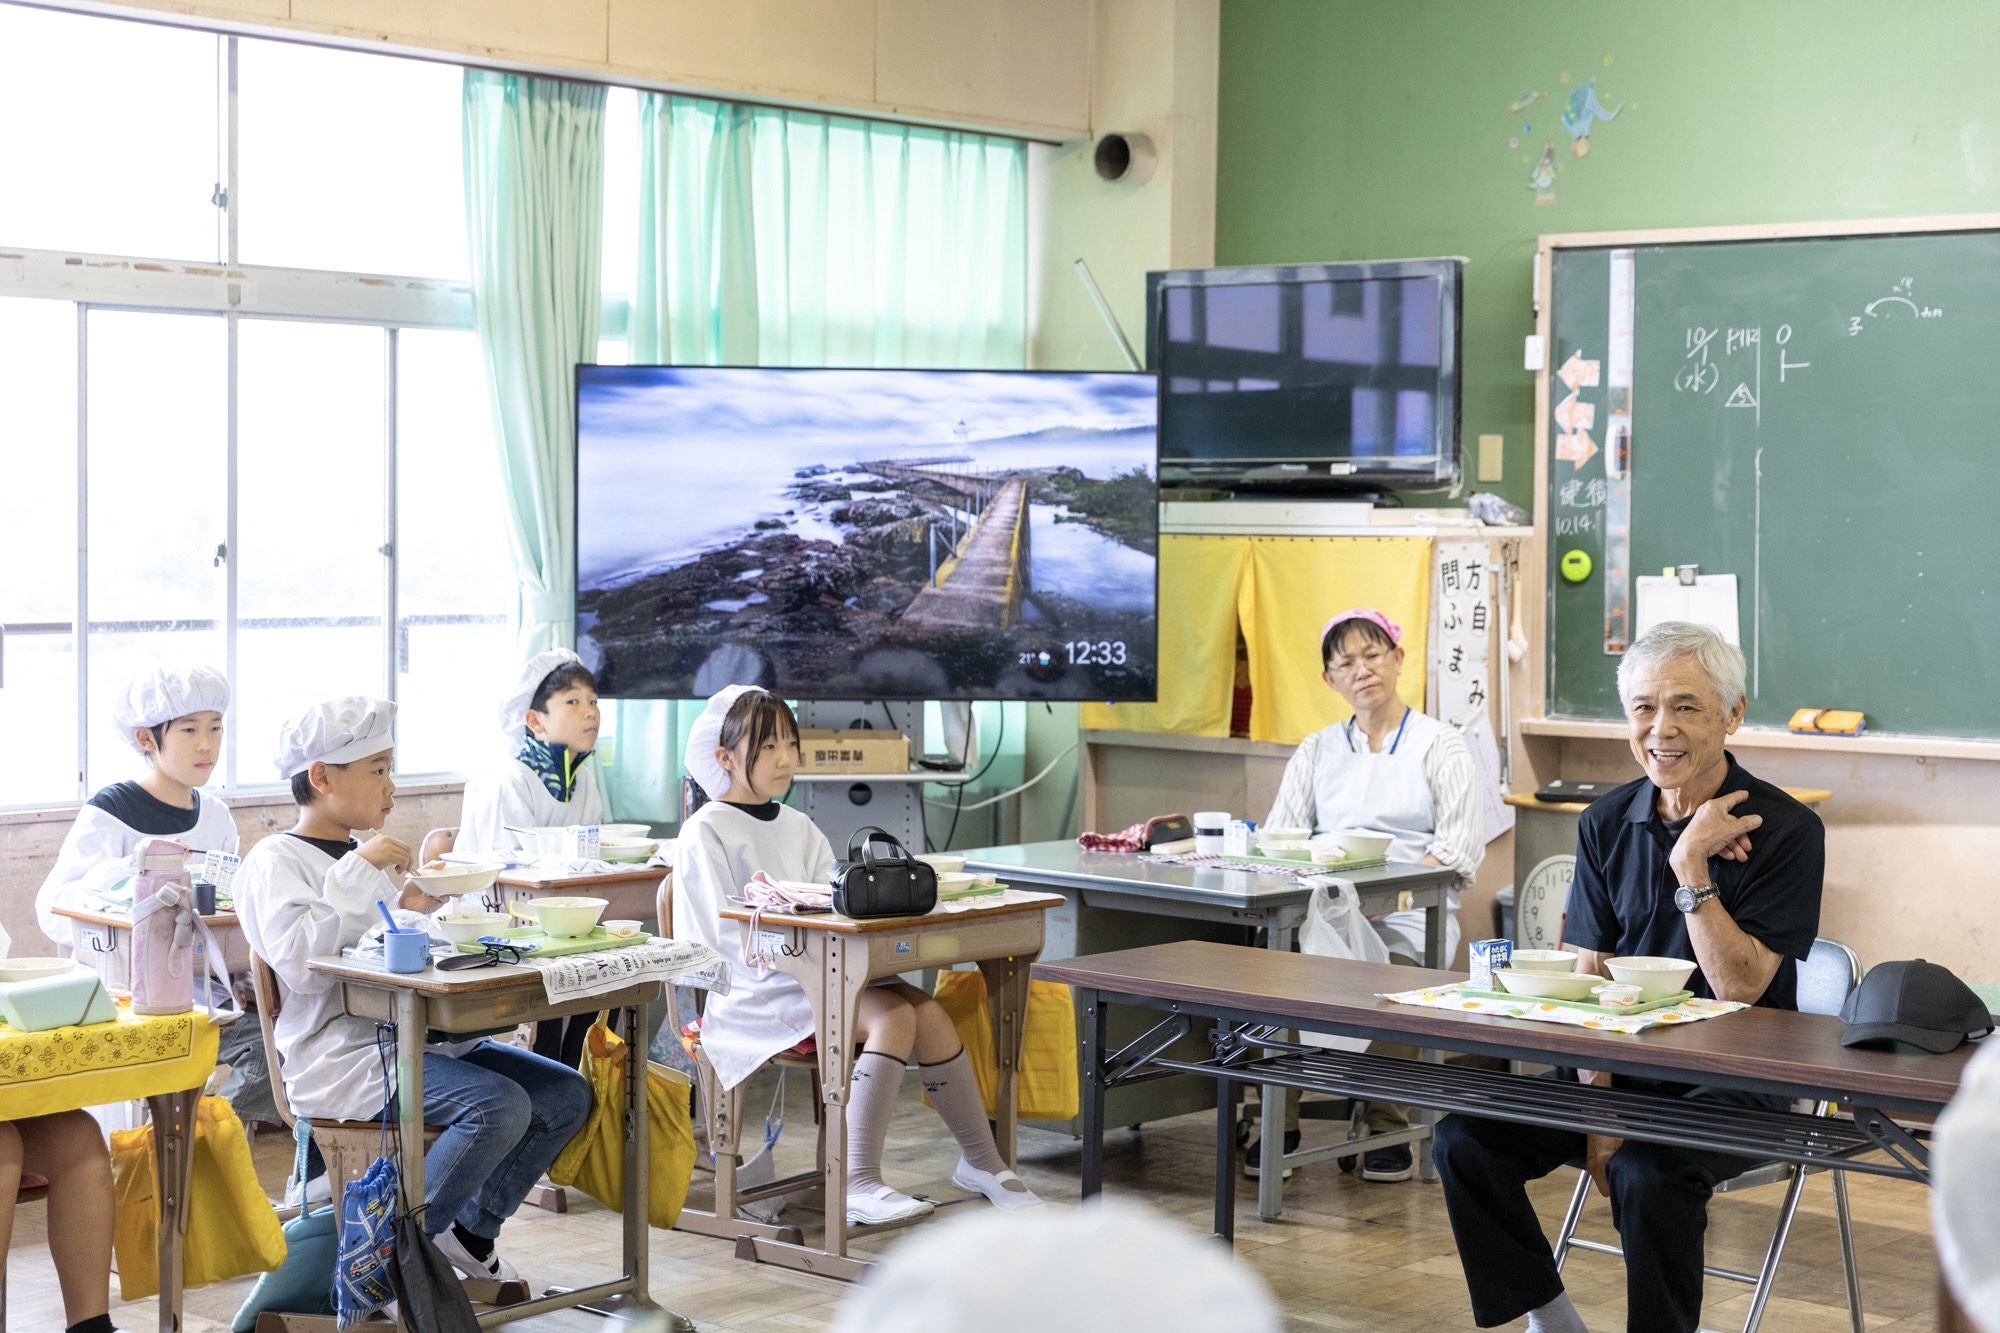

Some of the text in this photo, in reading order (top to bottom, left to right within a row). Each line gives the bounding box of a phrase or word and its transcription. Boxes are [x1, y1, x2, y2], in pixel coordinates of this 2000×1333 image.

[1019, 640, 1127, 665] 21° 12:33
[1545, 873, 1556, 887] 11
[1560, 869, 1573, 883] 12
[1530, 886, 1545, 900] 10
[1531, 906, 1539, 919] 9
[1535, 926, 1543, 941] 8
